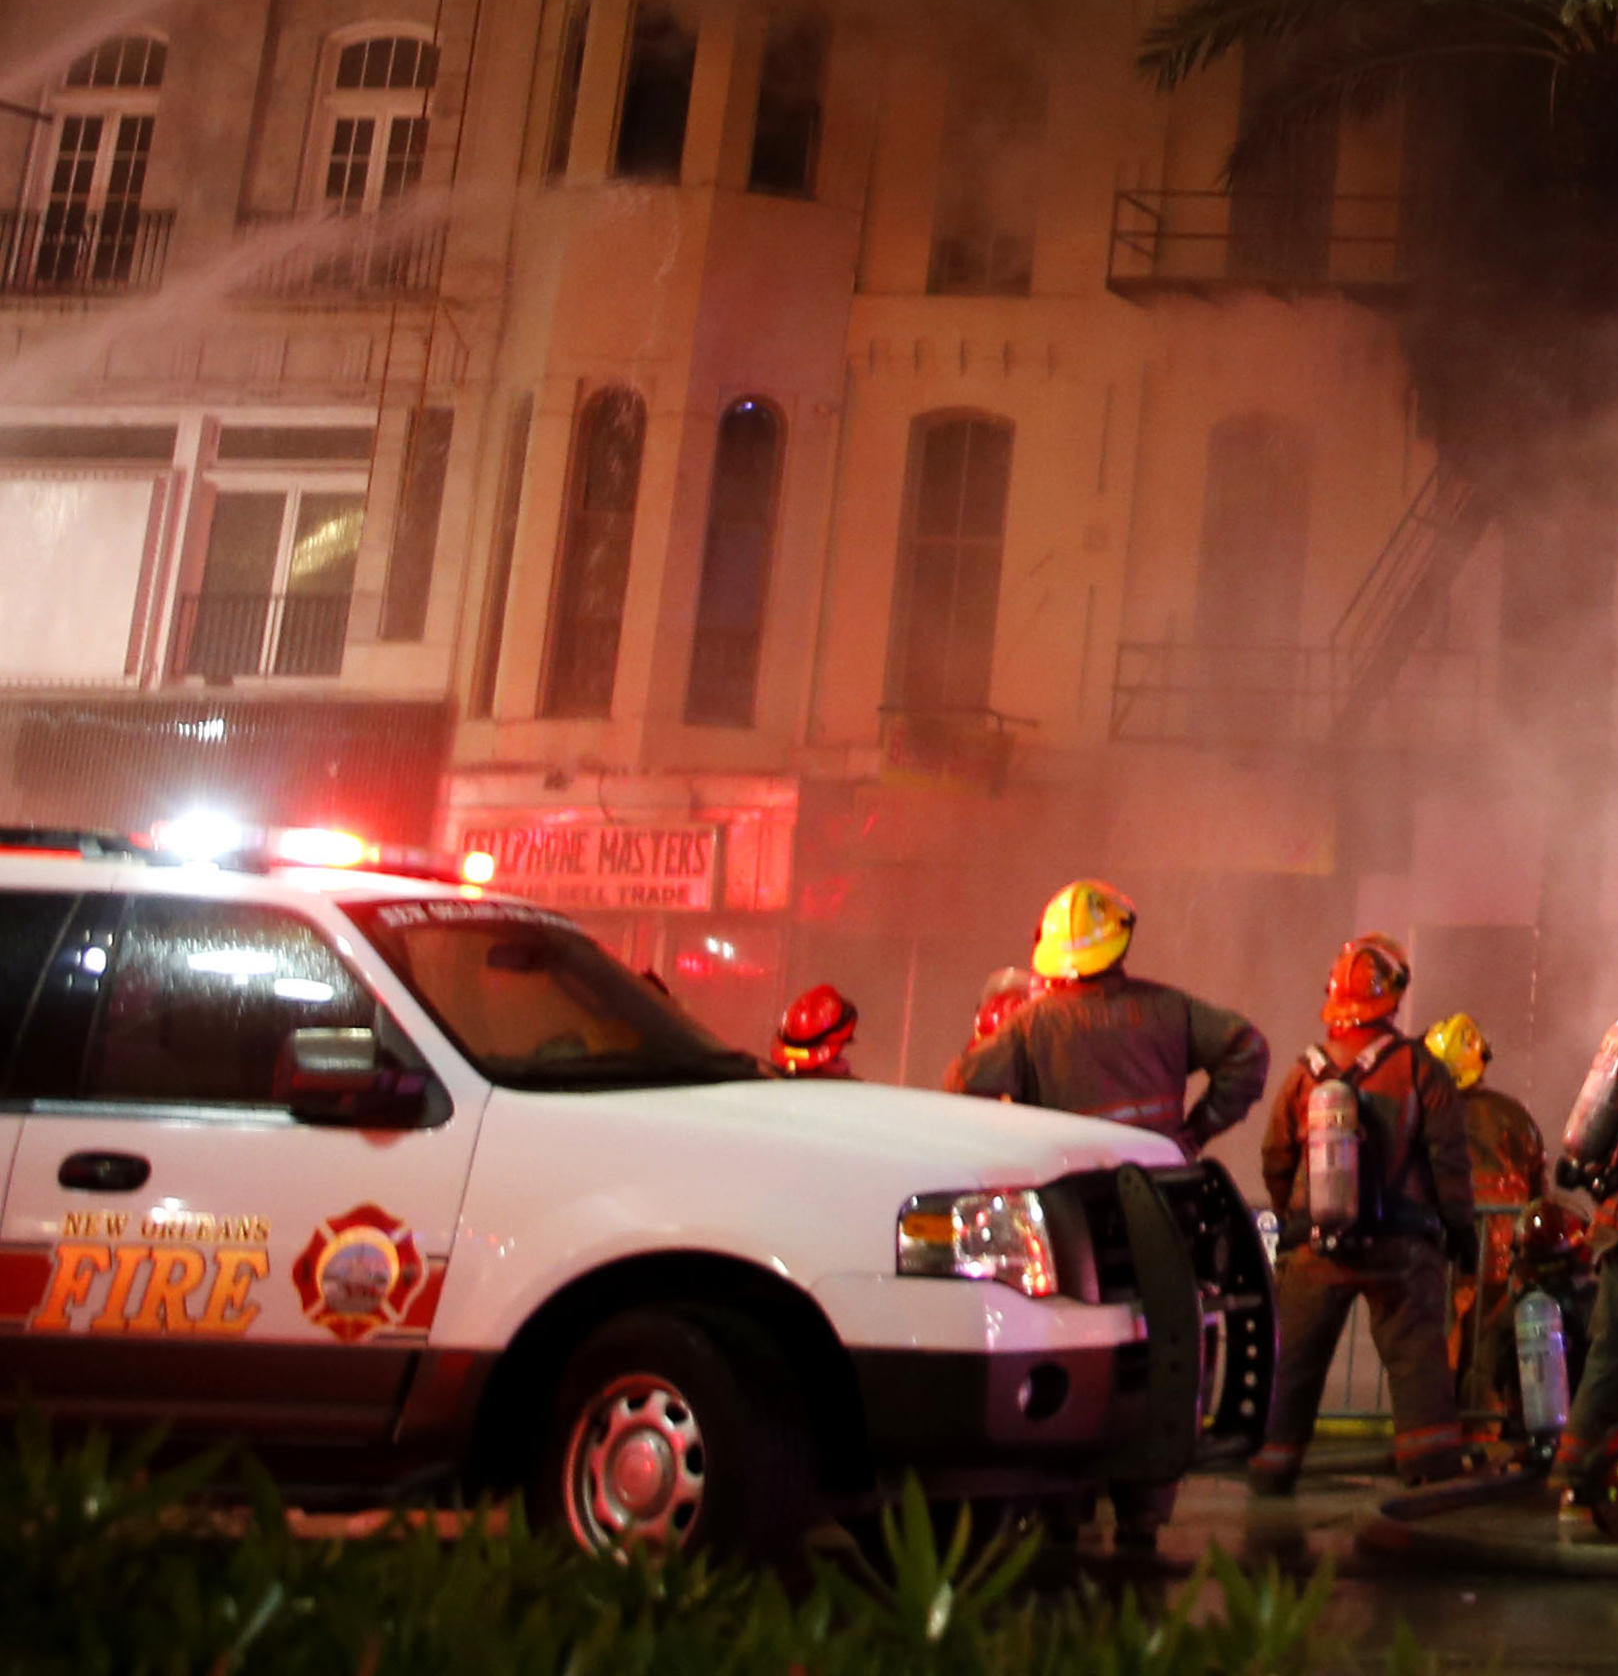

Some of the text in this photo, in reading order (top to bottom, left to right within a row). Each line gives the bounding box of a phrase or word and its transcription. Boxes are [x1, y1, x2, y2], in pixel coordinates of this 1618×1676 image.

[599, 830, 706, 875] MASTERS
[63, 1211, 128, 1239] NEW
[26, 1243, 270, 1334] FIRE
